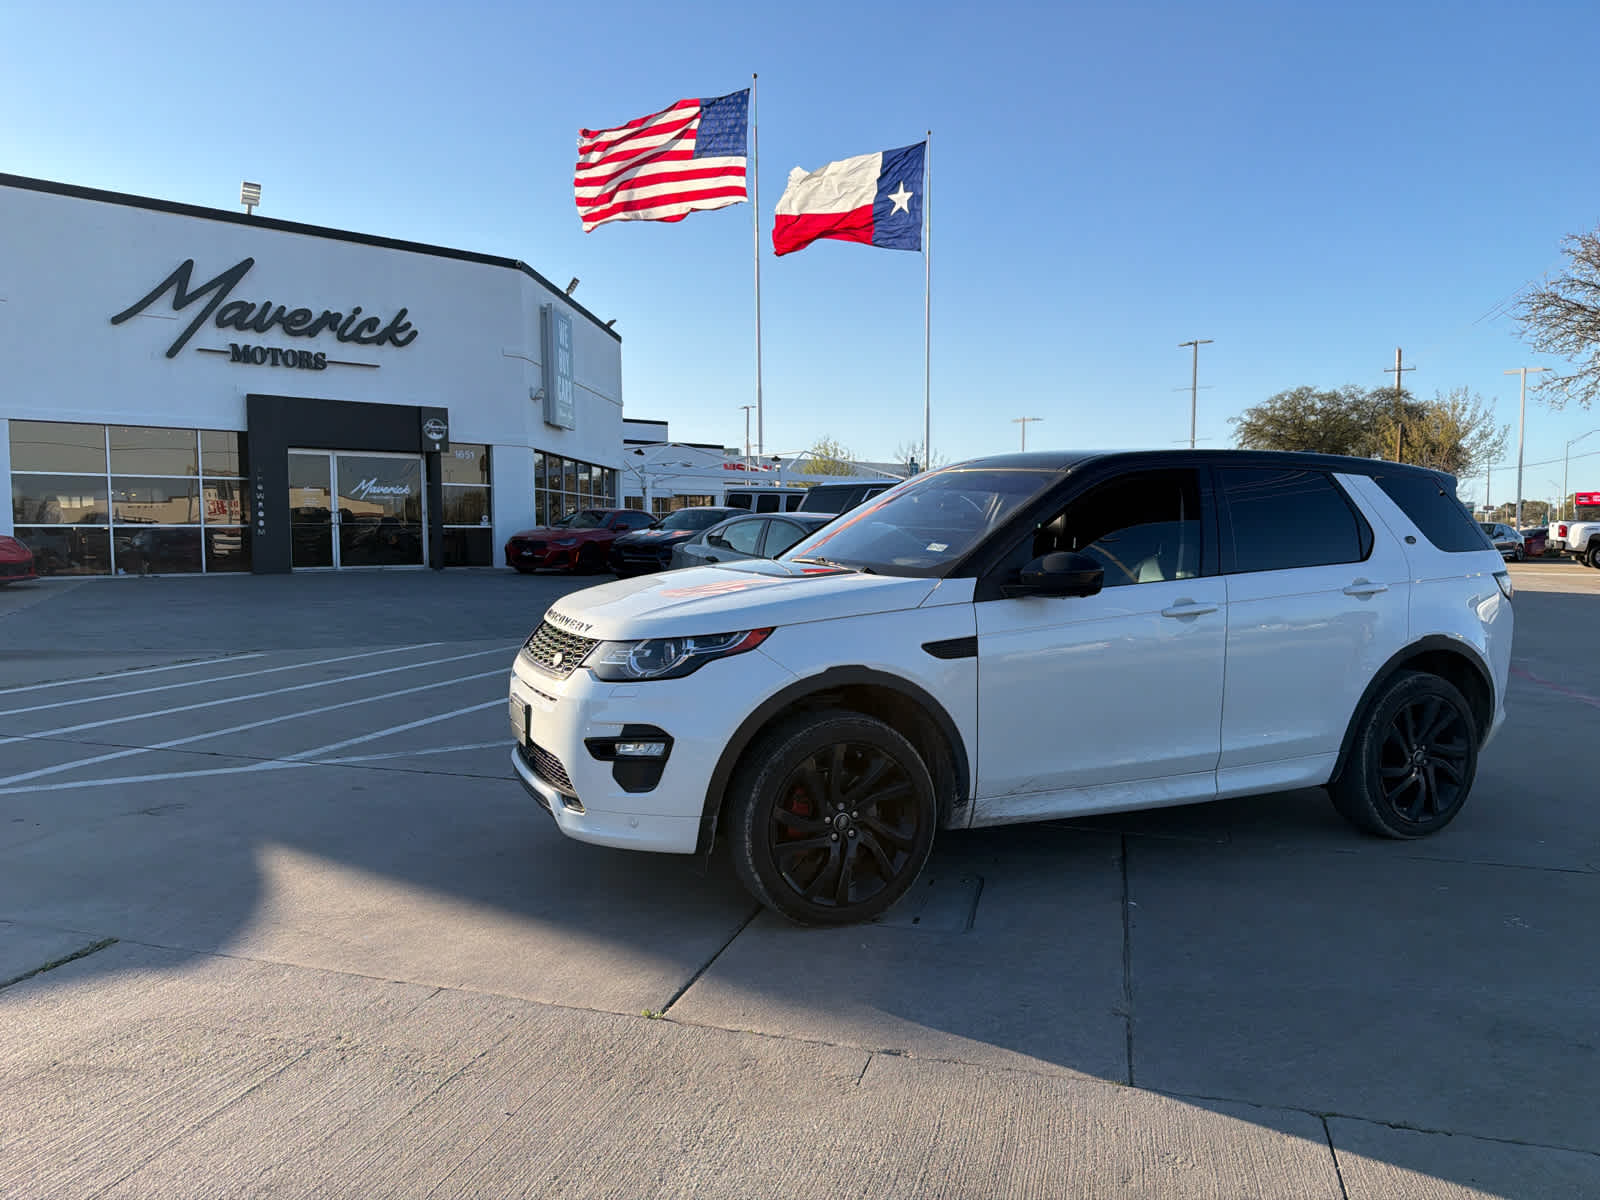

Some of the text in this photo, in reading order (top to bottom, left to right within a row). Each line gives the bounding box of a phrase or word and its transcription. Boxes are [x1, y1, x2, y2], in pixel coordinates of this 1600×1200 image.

[110, 256, 418, 359] Maverick
[558, 318, 569, 349] WE
[229, 343, 328, 370] MOTORS
[350, 477, 411, 500] Maverick
